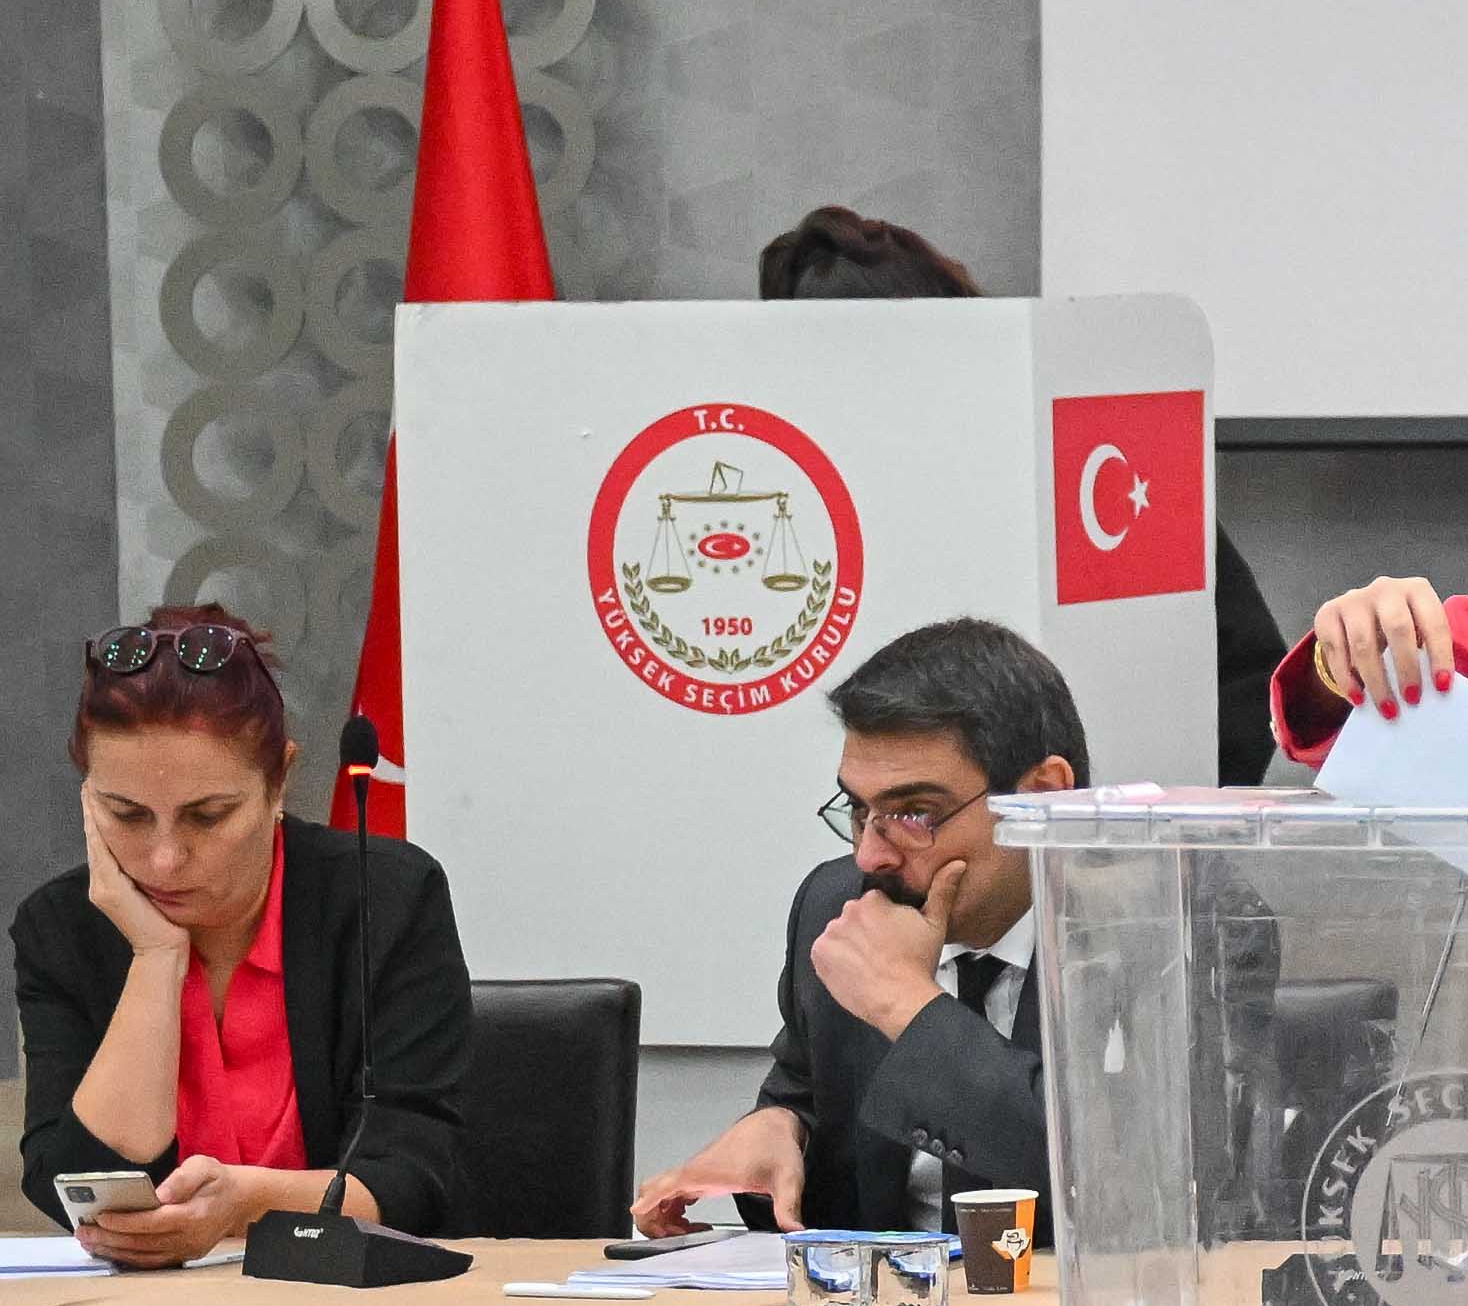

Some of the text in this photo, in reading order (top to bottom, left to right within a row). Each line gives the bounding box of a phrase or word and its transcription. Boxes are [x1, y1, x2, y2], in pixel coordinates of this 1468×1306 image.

[693, 408, 745, 432] T.C.
[701, 617, 754, 636] 1950
[599, 587, 857, 715] YÜKSEK SEÇİM KURULU
